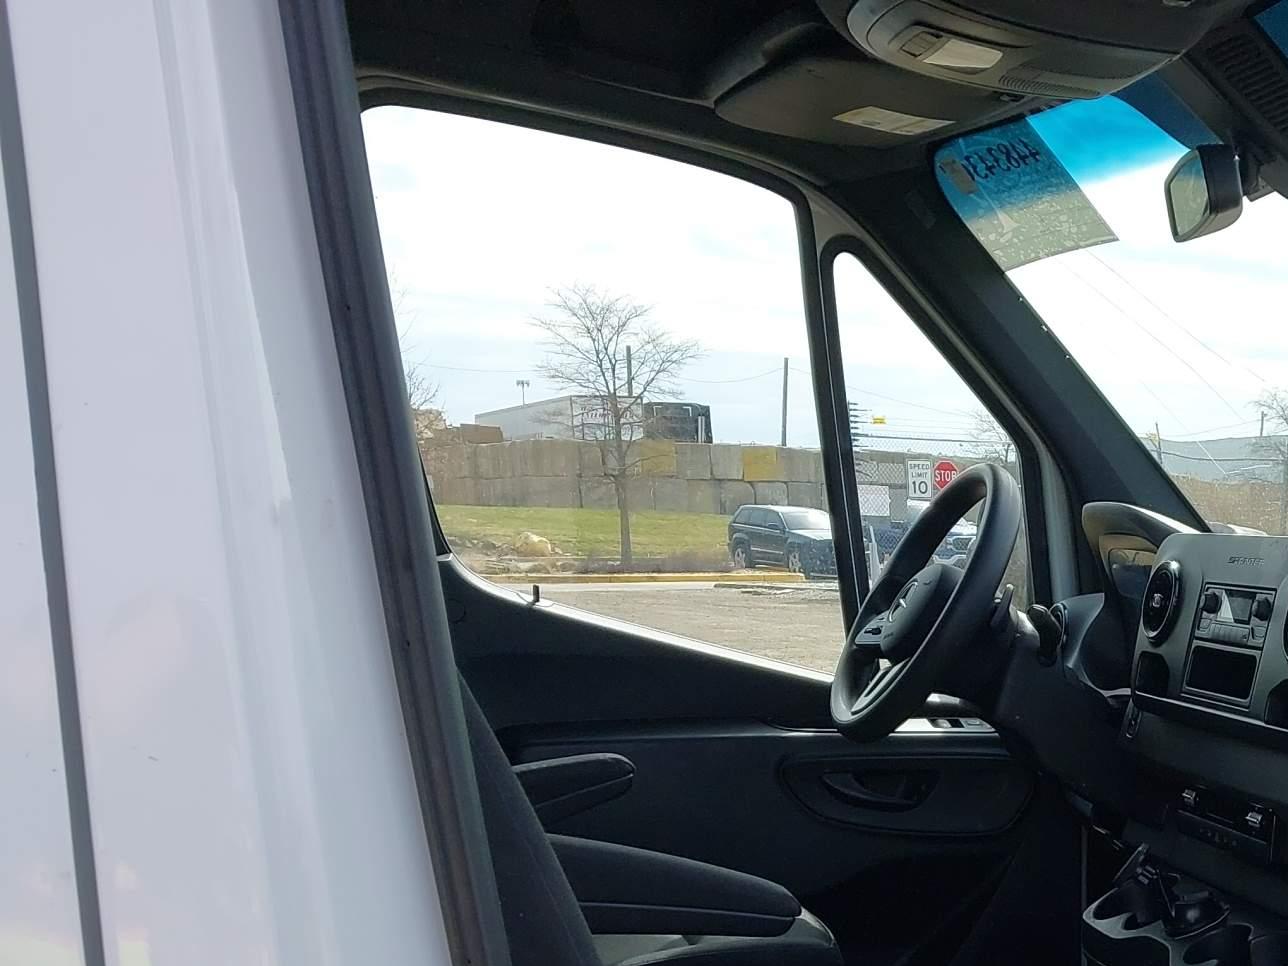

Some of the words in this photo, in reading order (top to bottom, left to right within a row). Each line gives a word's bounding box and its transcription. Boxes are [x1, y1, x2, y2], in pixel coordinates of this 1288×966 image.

[911, 471, 928, 479] LIMIT
[935, 470, 957, 482] STOP
[912, 480, 928, 495] 10
